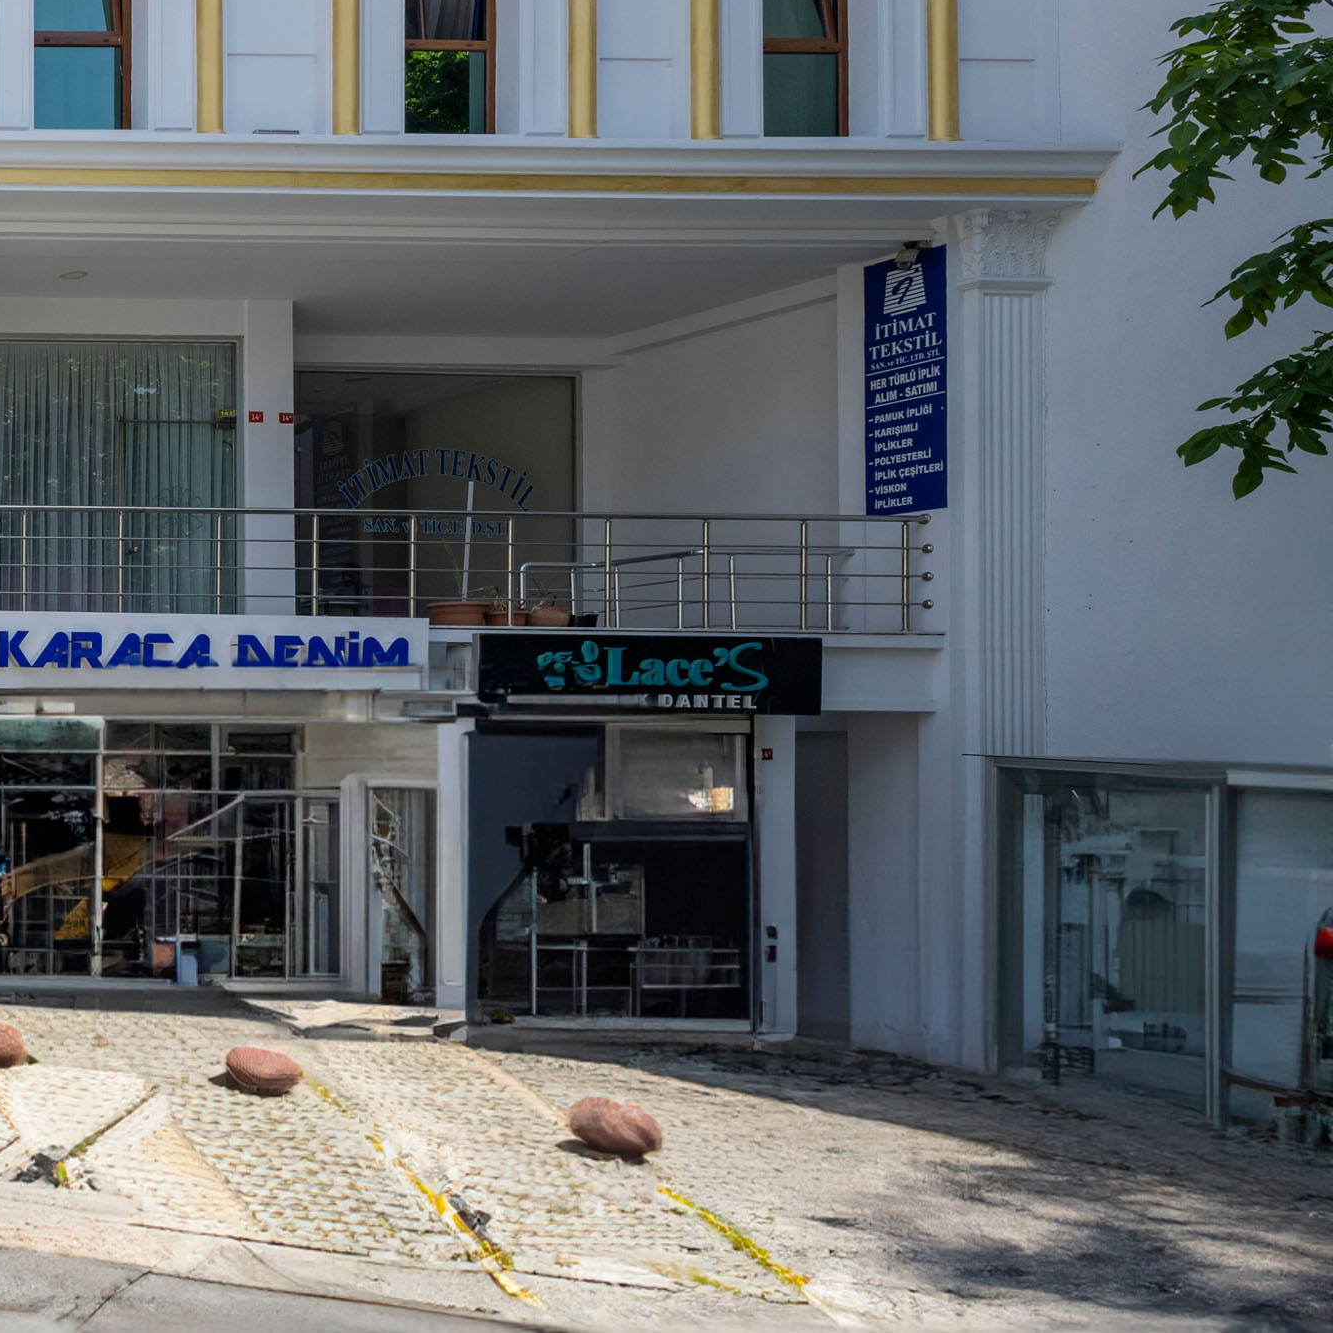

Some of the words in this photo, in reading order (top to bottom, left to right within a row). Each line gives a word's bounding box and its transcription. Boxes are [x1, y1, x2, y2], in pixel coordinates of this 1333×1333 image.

[874, 312, 937, 341] İTİMAT
[869, 330, 943, 360] TEKSTİL
[870, 377, 887, 391] HER
[918, 364, 941, 381] İPLİK
[874, 389, 898, 405] ALIM
[905, 381, 938, 398] SATIMI
[874, 438, 914, 453] İPLİKLER
[336, 449, 429, 509] İTİMAT
[436, 449, 534, 512] TEKSTİL
[874, 469, 897, 482] İPLİK
[874, 496, 913, 510] İPLİKLER
[364, 517, 400, 533] SAN.
[236, 630, 410, 668] DENİM
[657, 694, 758, 709] DANTEL
